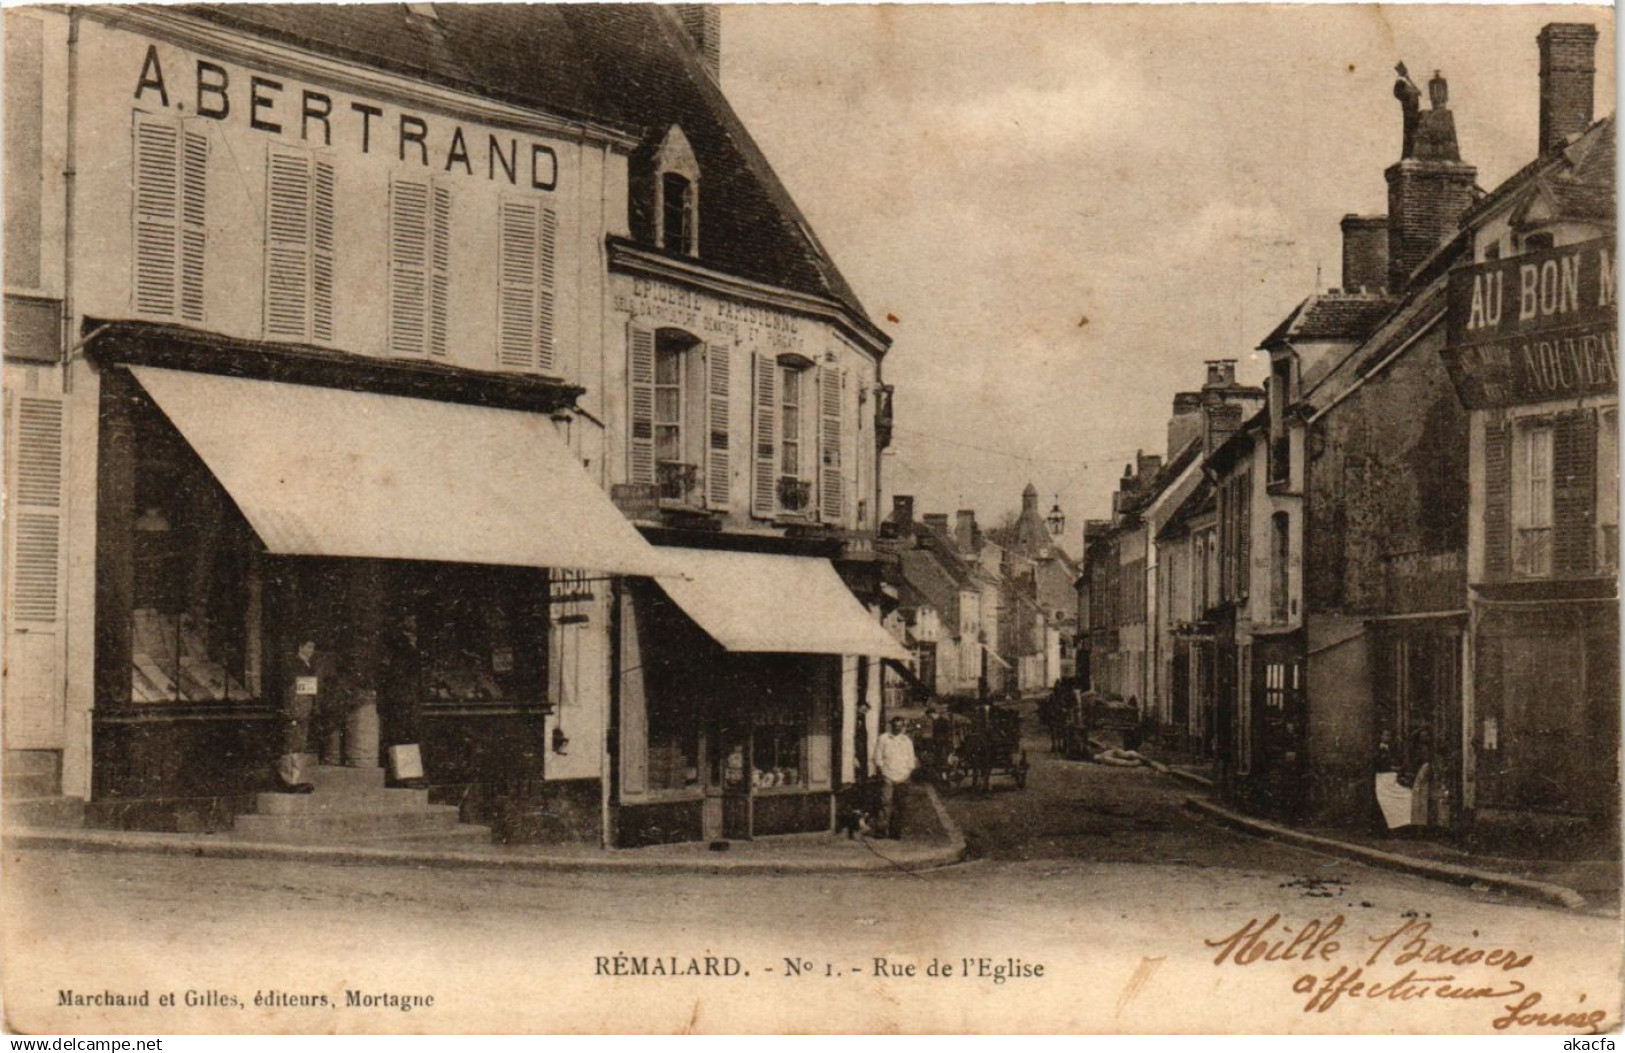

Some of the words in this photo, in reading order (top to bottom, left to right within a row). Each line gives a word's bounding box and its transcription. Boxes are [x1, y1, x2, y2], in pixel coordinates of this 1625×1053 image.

[1466, 270, 1503, 331] AU
[1518, 250, 1582, 321] BON
[594, 949, 751, 977] RÉMALARD.
[873, 957, 916, 977] Rue
[926, 957, 953, 977] de
[961, 957, 1045, 985] l'Eglise
[57, 989, 150, 1008] Marchand
[158, 991, 176, 1008] et
[184, 989, 245, 1010] Gilles,
[253, 989, 336, 1009] éditeurs,
[344, 989, 435, 1012] Mortagne
[1492, 992, 1607, 1032] Louise
